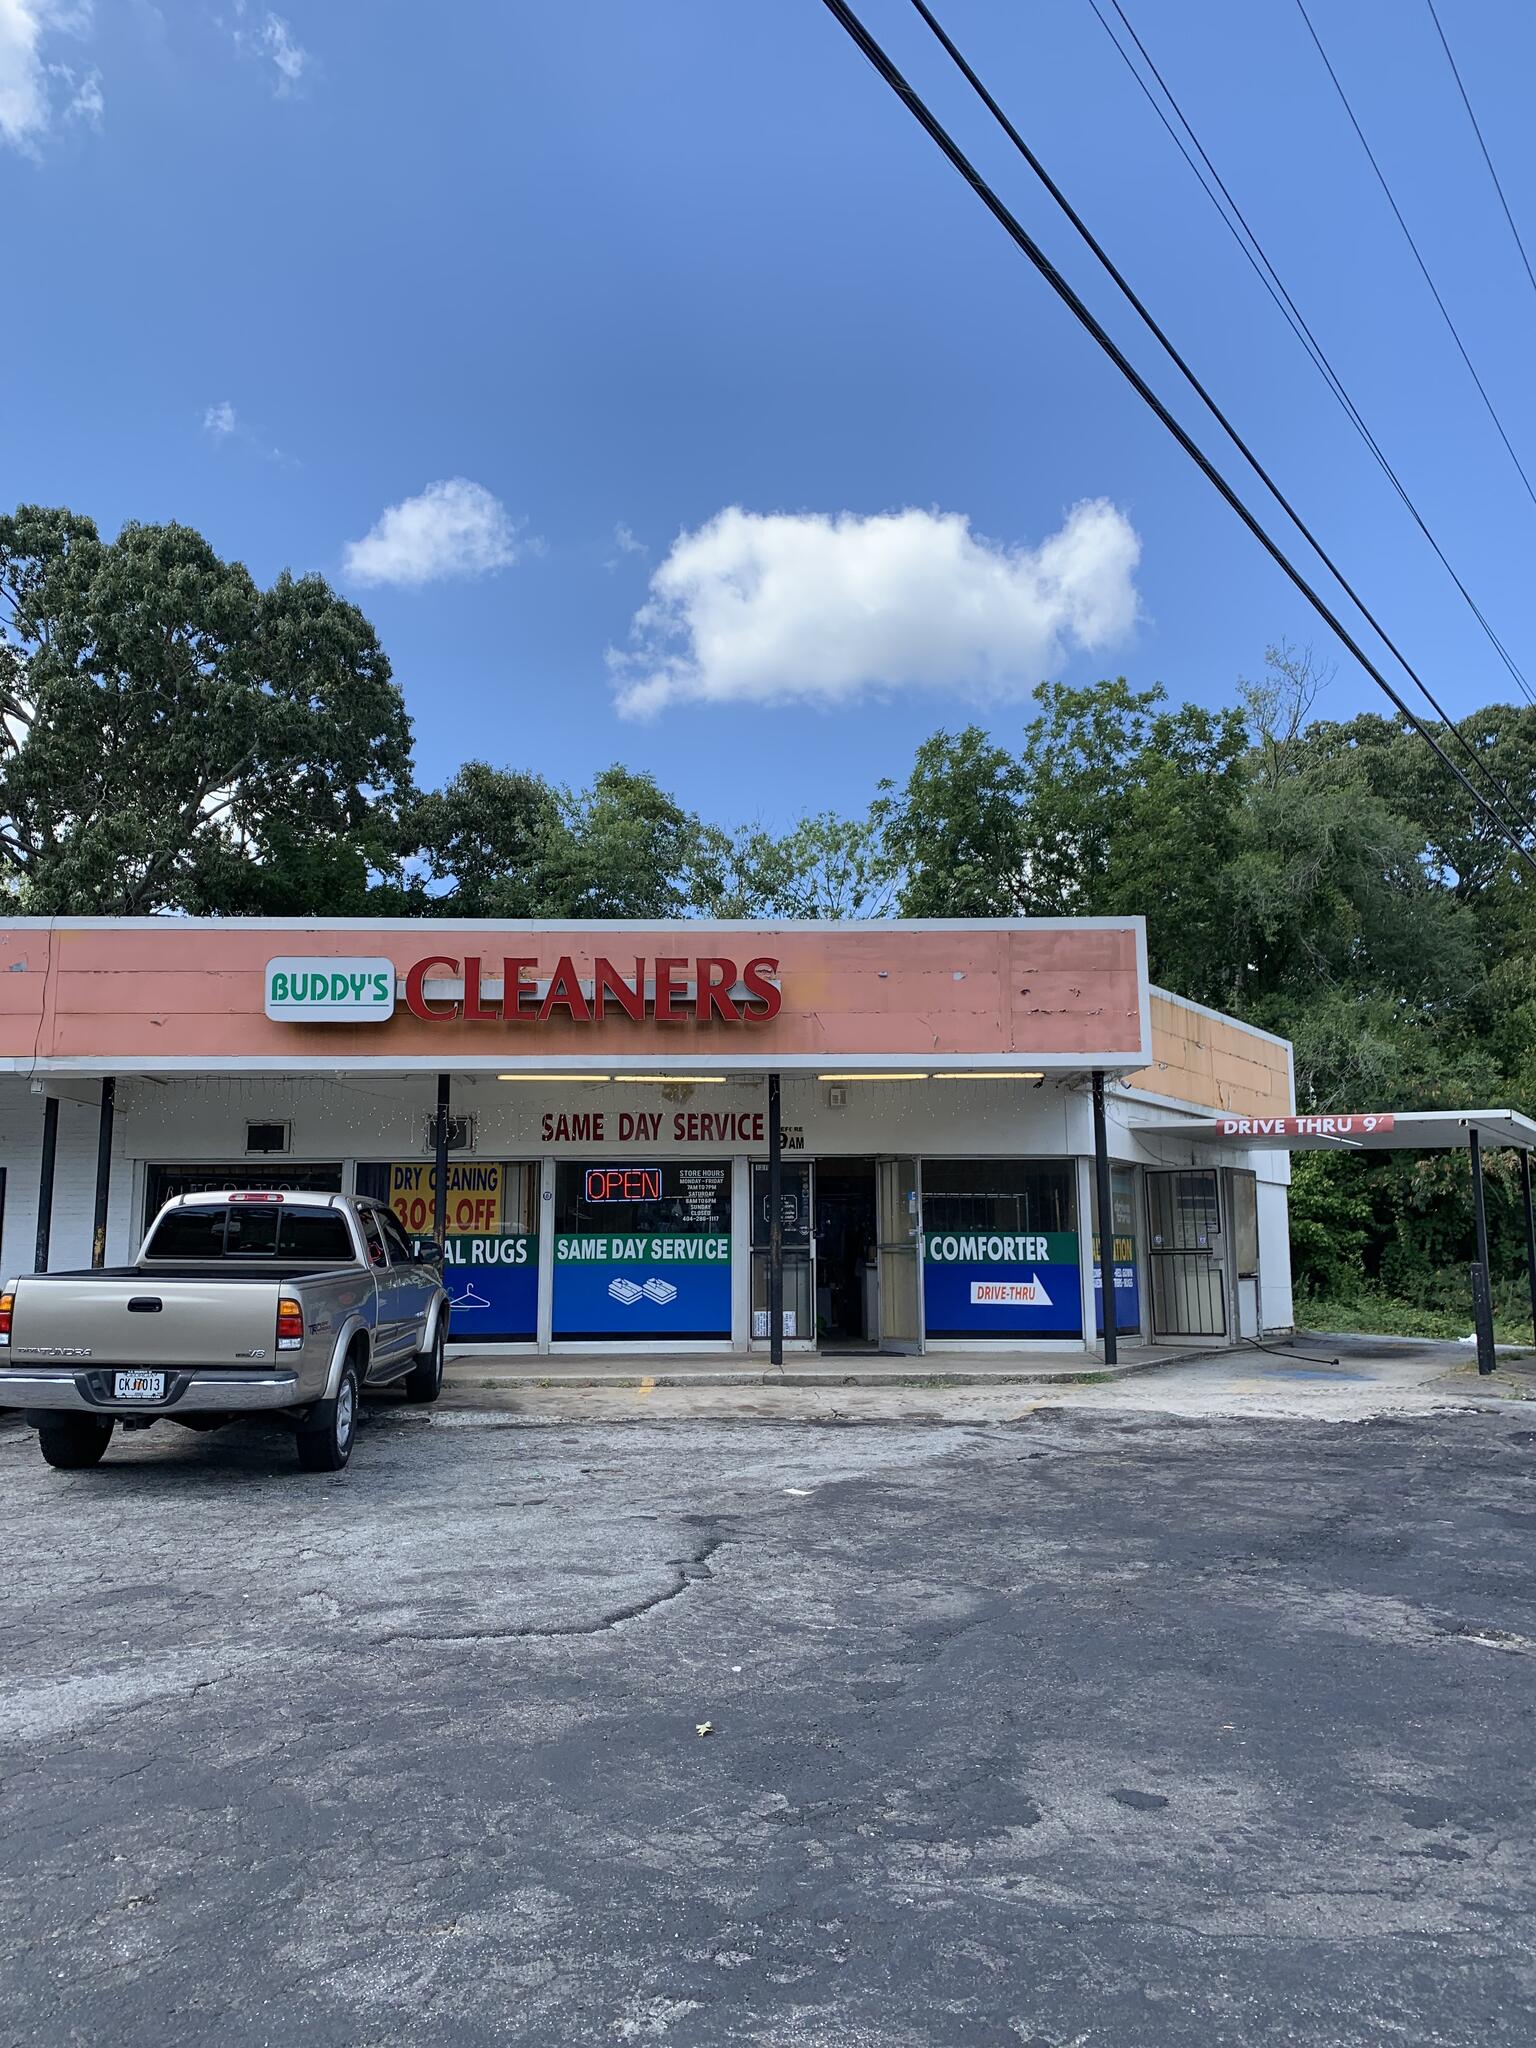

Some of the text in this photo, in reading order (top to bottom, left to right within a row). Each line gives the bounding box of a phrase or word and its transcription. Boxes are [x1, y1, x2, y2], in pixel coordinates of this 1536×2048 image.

[271, 955, 783, 1022] BUDDY'S CLEANERS
[541, 1112, 765, 1142] SAME DAY SERVICE
[1223, 1119, 1285, 1135] DRIVE
[1295, 1117, 1353, 1134] THRU
[393, 1166, 499, 1192] DRY CEANING
[588, 1171, 659, 1199] OPEN
[455, 1198, 497, 1232] OFF
[471, 1238, 528, 1265] RUGS
[557, 1238, 729, 1260] SAME DAY SERVICE
[929, 1236, 1050, 1261] COMFORTER
[976, 1285, 1036, 1301] DRIVE-THRU
[40, 1347, 93, 1357] TUNDRA
